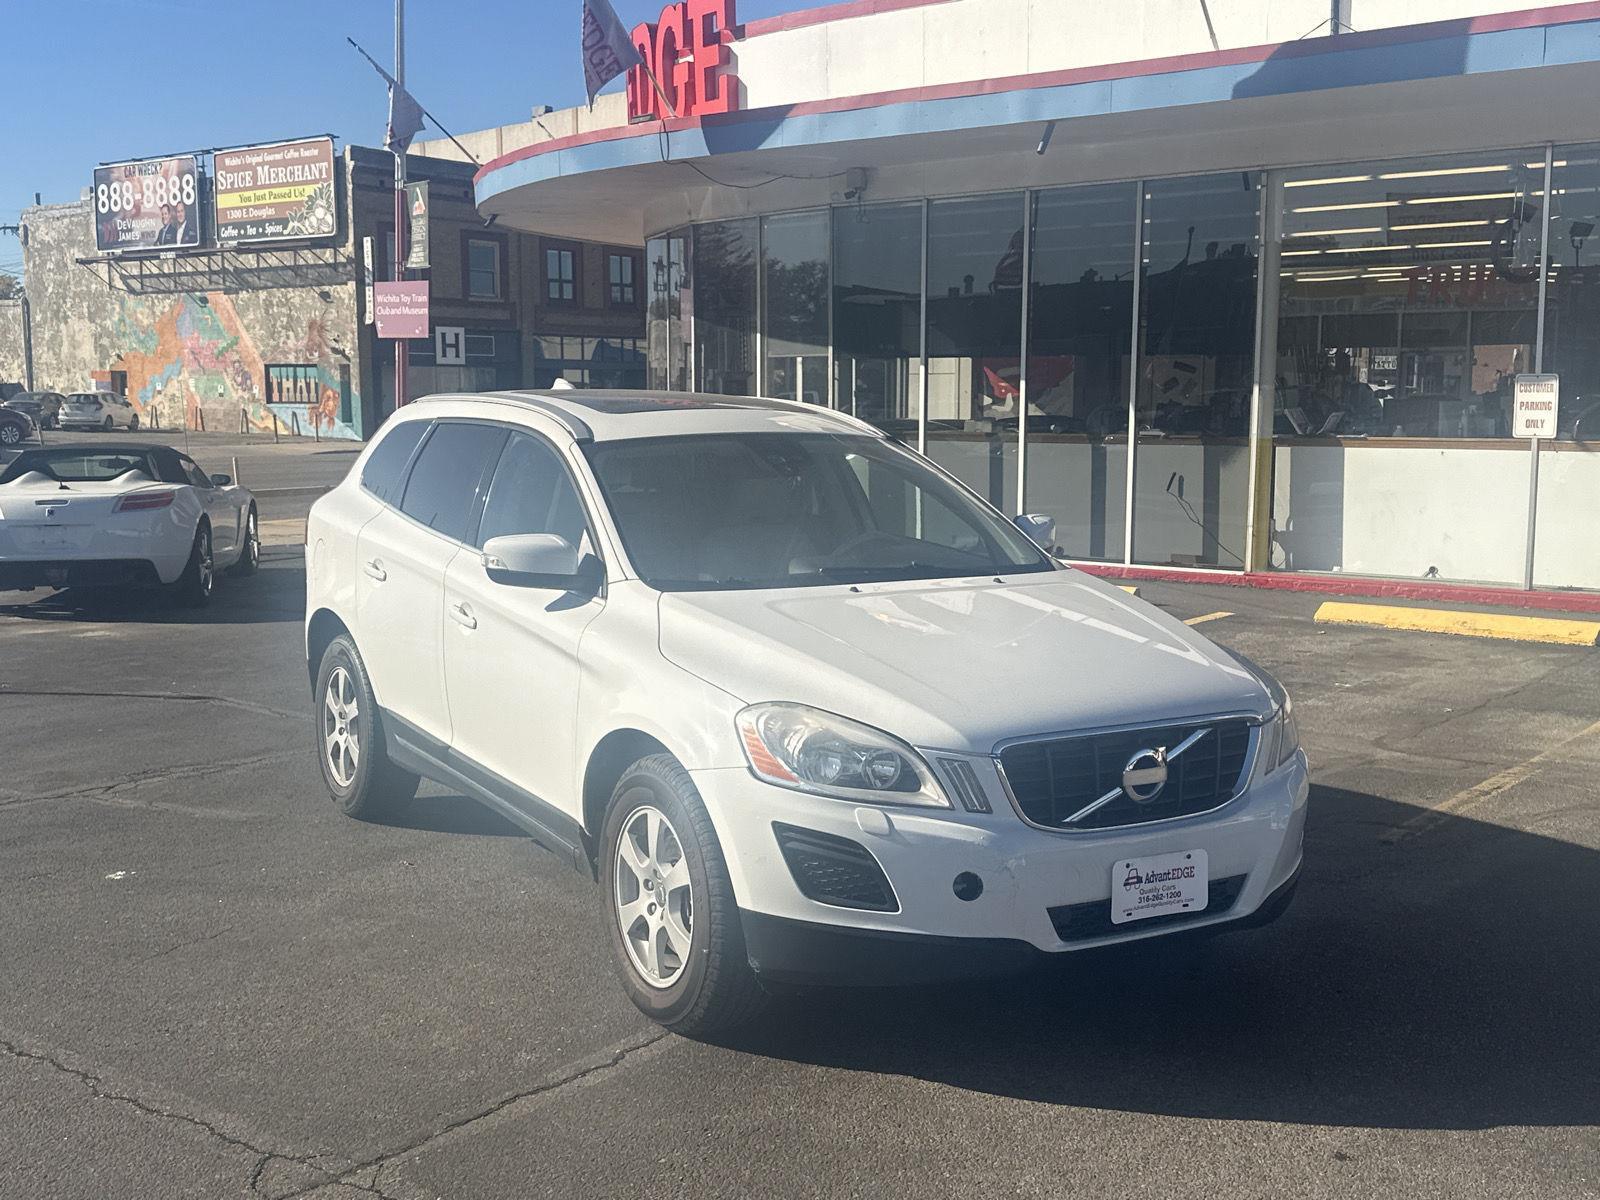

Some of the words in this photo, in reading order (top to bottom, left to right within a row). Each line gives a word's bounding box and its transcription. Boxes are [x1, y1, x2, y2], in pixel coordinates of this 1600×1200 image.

[284, 148, 299, 160] Coffee
[98, 174, 195, 214] 888-8888
[238, 193, 252, 204] You
[253, 192, 267, 202] Just
[268, 189, 291, 200] Passed
[293, 188, 305, 198] Us!
[226, 209, 242, 220] 1300
[249, 206, 275, 218] Douglas
[117, 230, 140, 242] JAMES
[221, 226, 238, 238] Coffee
[246, 225, 257, 235] Tea
[265, 222, 282, 236] Spices
[377, 294, 400, 303] Wichita
[400, 294, 411, 305] Toy
[412, 293, 428, 303] Train
[402, 306, 428, 316] Museum
[441, 332, 460, 358] H
[1519, 383, 1554, 393] CUSTOMER
[1520, 401, 1553, 411] PARKING
[1525, 418, 1545, 429] ONLY
[1144, 866, 1195, 884] AdvantEDGE
[1139, 885, 1160, 896] Quality
[1162, 884, 1176, 892] Cars
[1137, 890, 1182, 904] 316-262-1200
